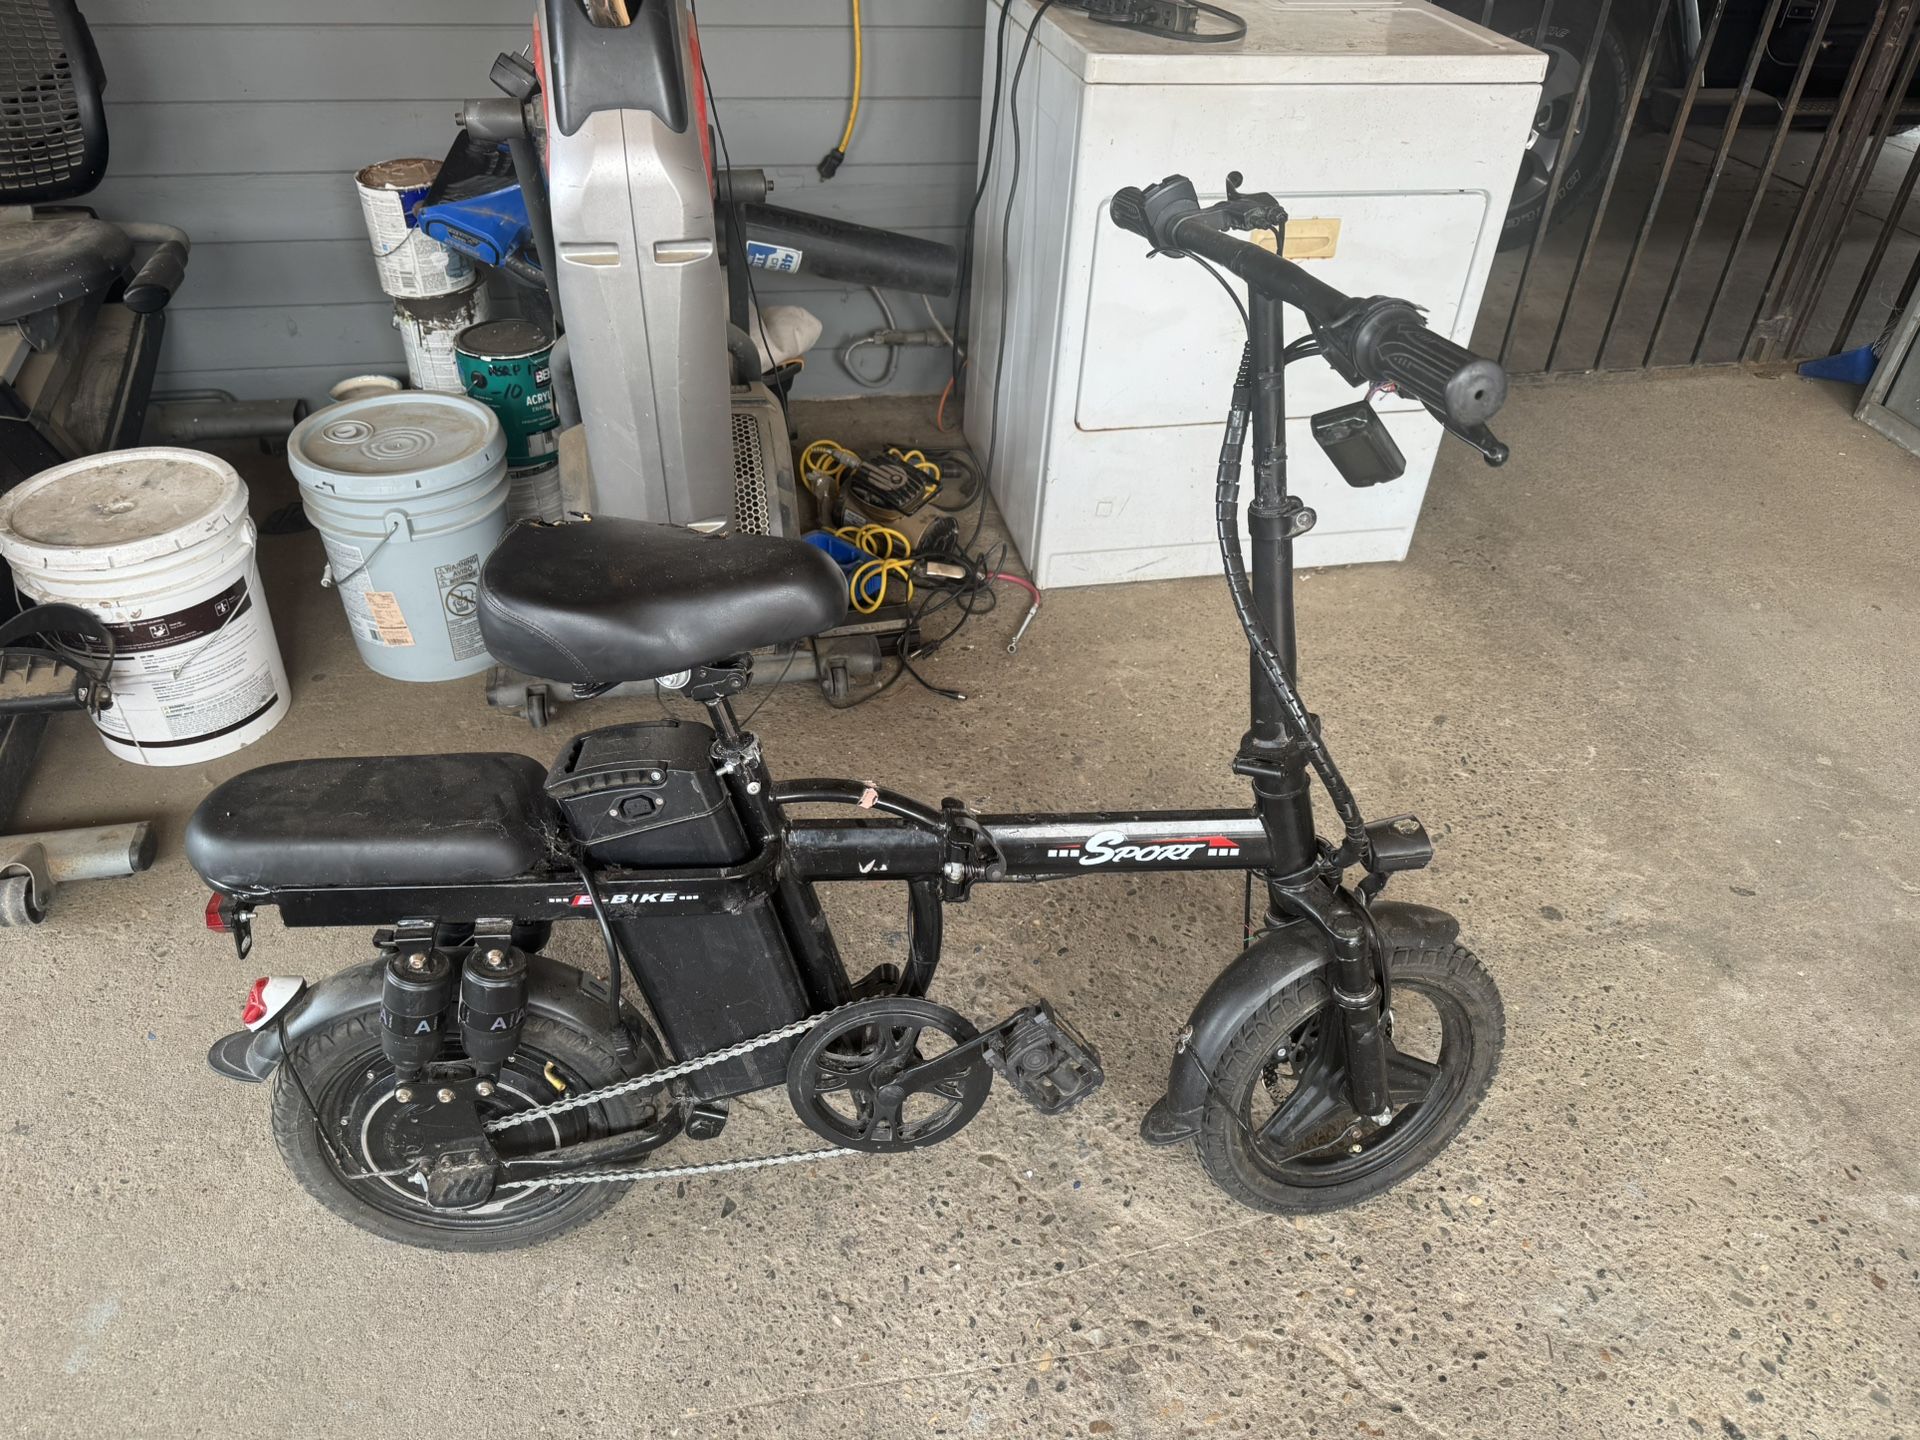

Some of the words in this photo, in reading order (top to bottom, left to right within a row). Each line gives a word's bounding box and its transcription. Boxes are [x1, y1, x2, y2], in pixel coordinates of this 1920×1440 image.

[444, 556, 477, 573] WARNING
[453, 565, 472, 577] AVISO
[414, 1020, 431, 1034] A
[490, 1016, 507, 1030] A
